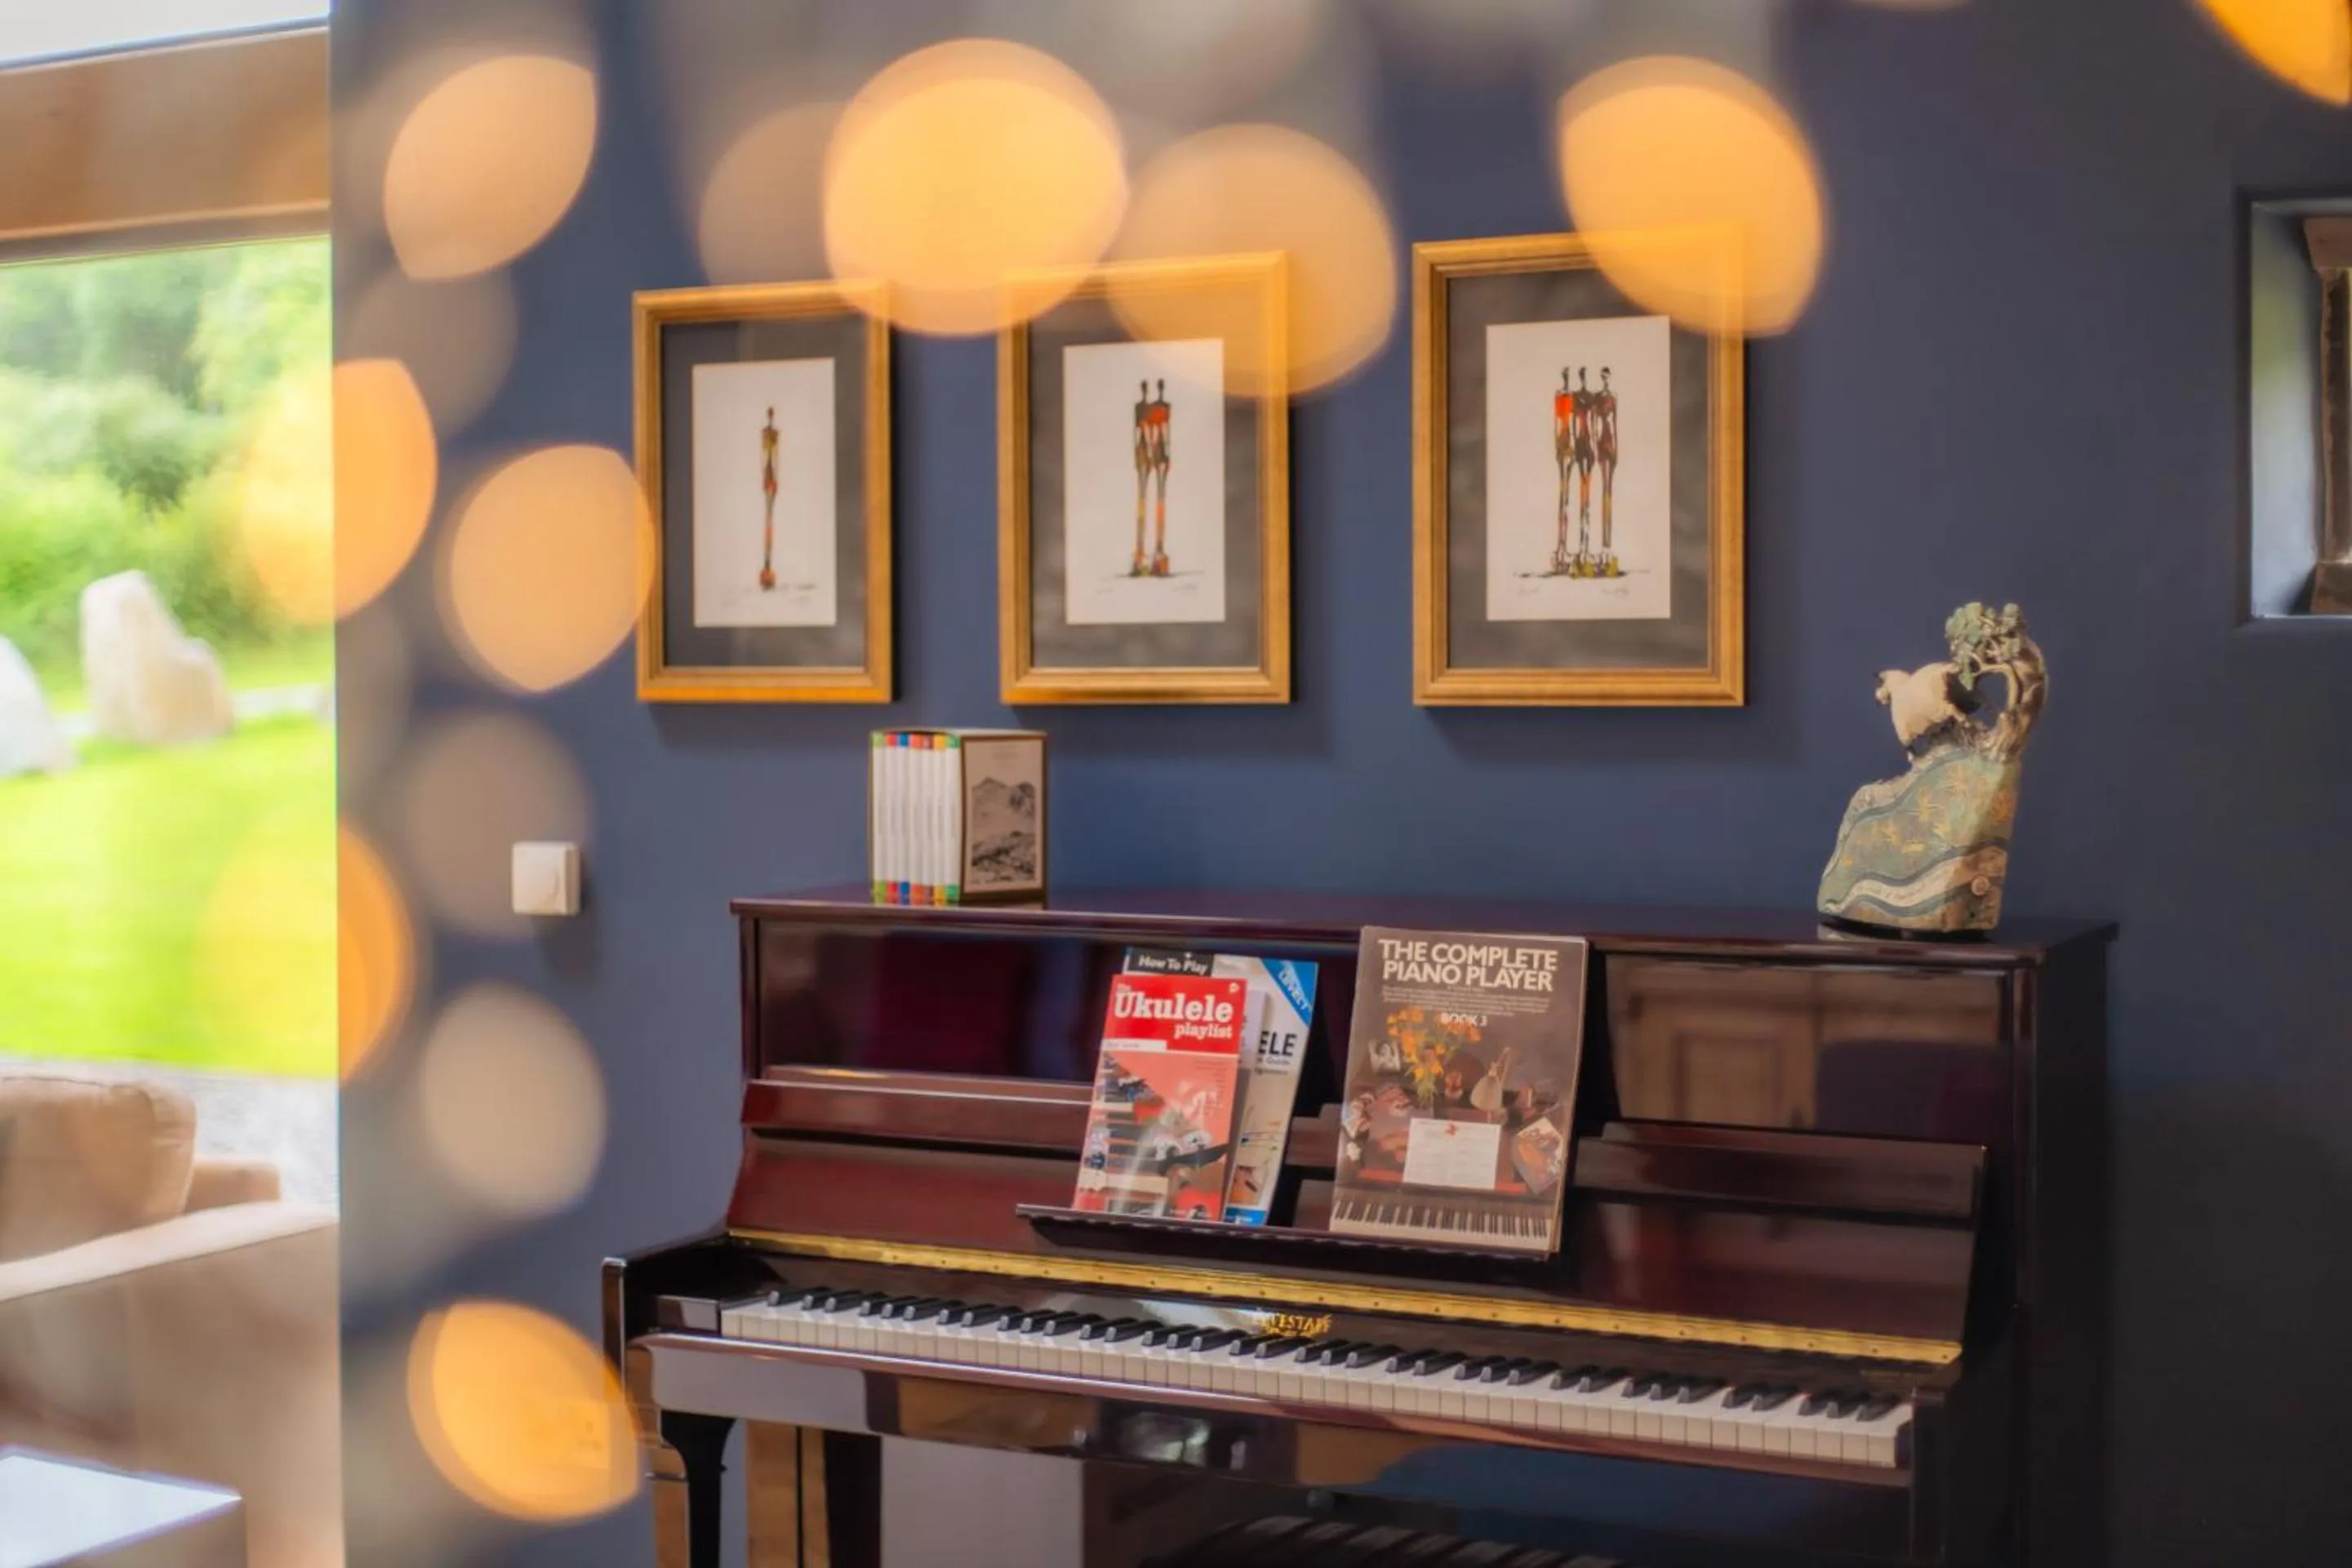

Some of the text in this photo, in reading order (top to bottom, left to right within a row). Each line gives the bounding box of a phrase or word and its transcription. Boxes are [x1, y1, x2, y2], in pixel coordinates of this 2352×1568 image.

[1137, 955, 1208, 975] How To Play
[1377, 939, 1558, 971] THE COMPLETE
[1382, 960, 1554, 992] PIANO PLAYER
[1114, 990, 1234, 1023] Ukulele
[1440, 1012, 1478, 1026] BOOK
[1174, 1023, 1233, 1041] playlist
[1258, 1030, 1297, 1056] ELE
